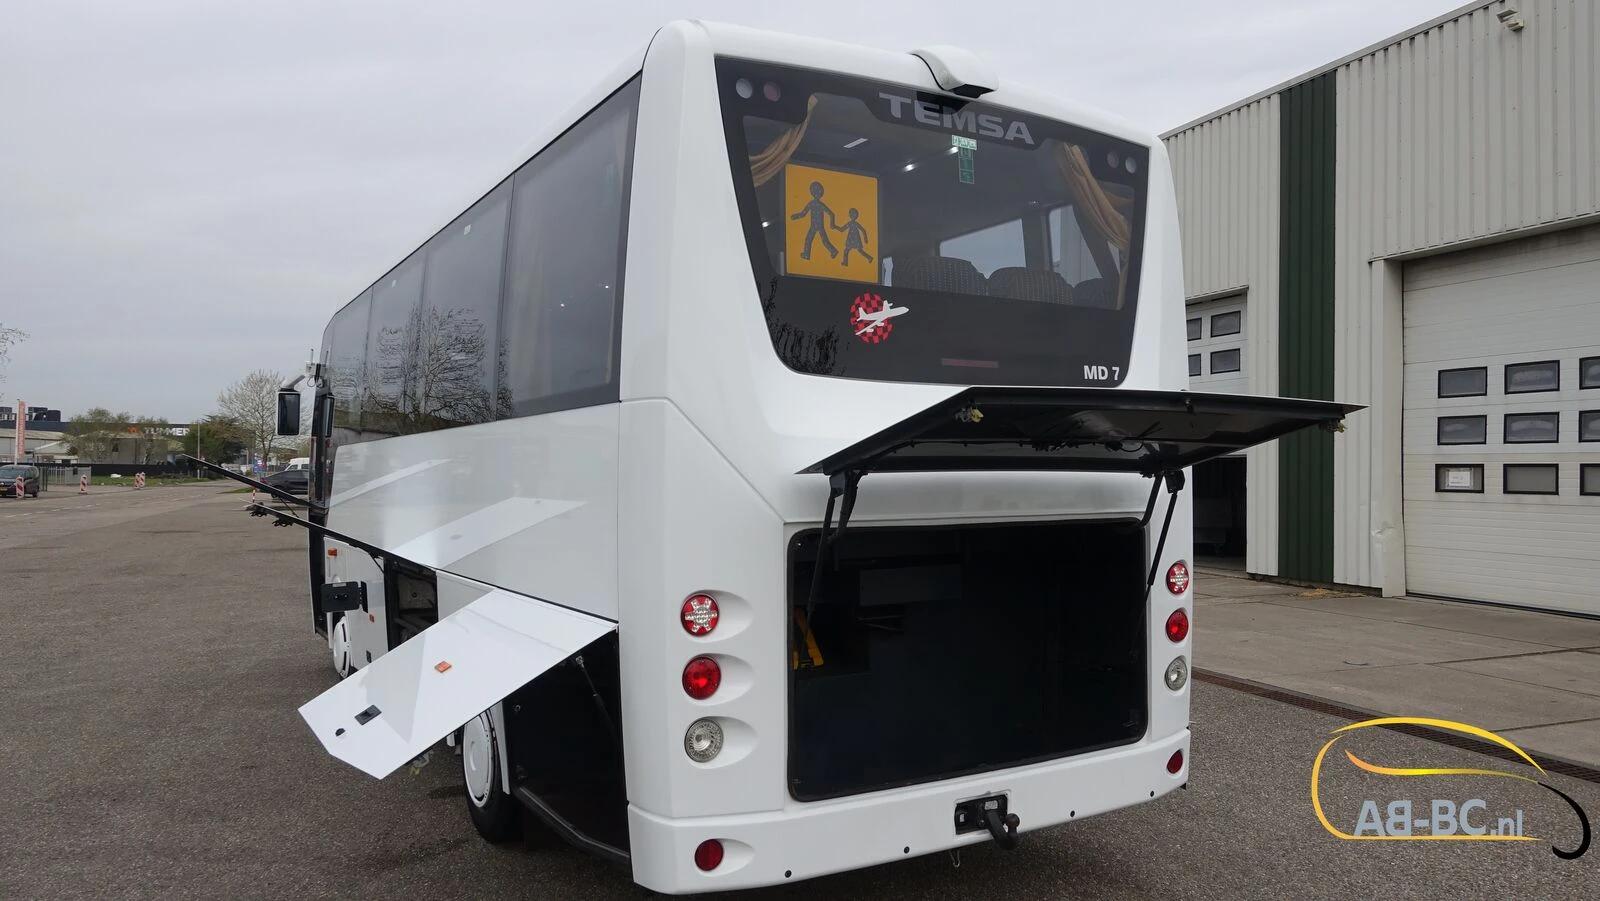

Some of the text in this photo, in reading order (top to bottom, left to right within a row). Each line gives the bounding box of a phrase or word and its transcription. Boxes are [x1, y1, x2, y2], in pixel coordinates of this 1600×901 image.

[878, 92, 1035, 145] TEMSA
[1083, 365, 1120, 381] MD 7
